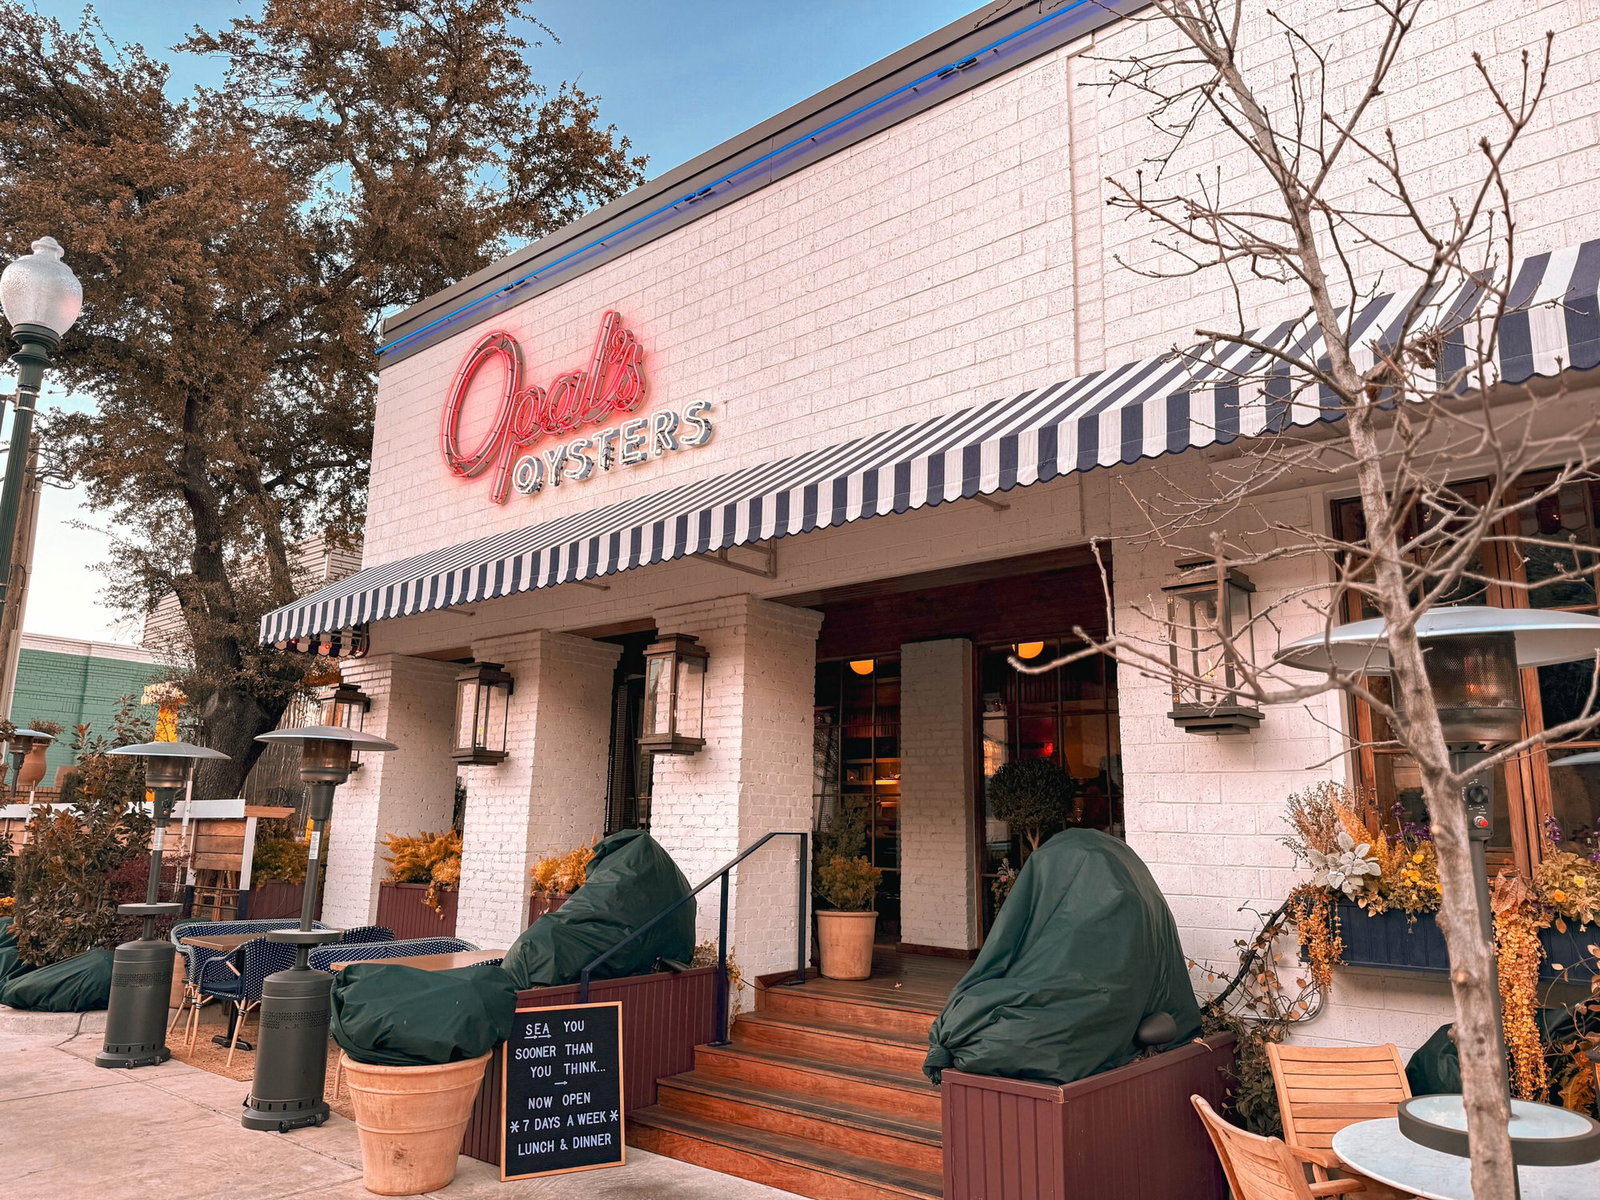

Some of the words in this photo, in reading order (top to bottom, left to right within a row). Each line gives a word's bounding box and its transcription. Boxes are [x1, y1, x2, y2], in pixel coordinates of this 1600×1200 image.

[440, 309, 648, 505] Opal's
[512, 399, 713, 495] OYSTERS
[525, 1022, 550, 1035] SEA
[563, 1020, 585, 1033] YOU
[515, 1045, 557, 1060] SOONER
[565, 1042, 593, 1056] THAN
[530, 1065, 551, 1078] YOU
[563, 1061, 606, 1075] THINK...
[528, 1096, 553, 1110] NOW
[562, 1092, 591, 1106] OPEN
[522, 1119, 529, 1132] 7
[534, 1116, 561, 1131] DAYS
[566, 1114, 575, 1127] A
[577, 1111, 607, 1126] WEEK
[517, 1139, 555, 1156] LUNCH
[559, 1138, 569, 1150] &
[572, 1132, 612, 1149] DINNER
